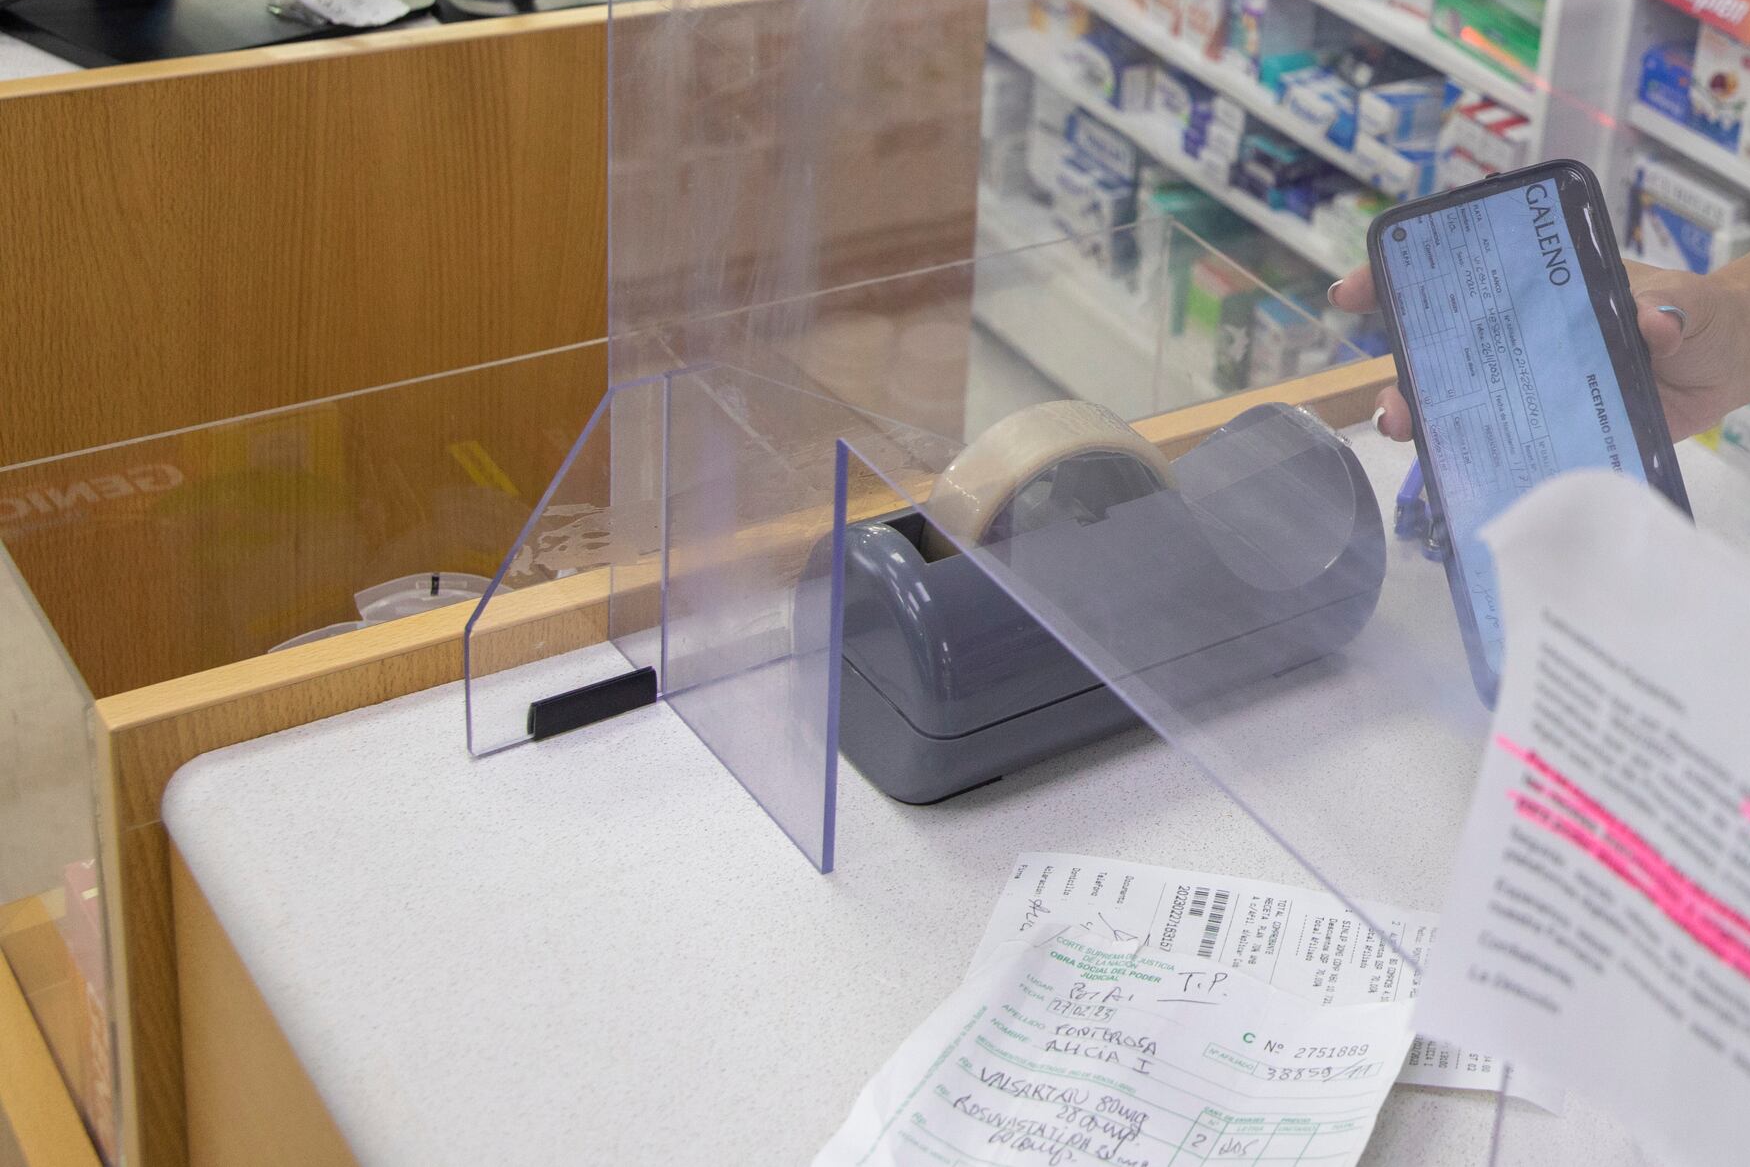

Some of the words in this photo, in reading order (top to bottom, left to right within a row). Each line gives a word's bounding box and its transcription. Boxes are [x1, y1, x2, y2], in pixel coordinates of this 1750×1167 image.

[1525, 184, 1571, 288] GALENO
[1586, 373, 1611, 434] RECETARIO
[1604, 436, 1617, 452] DE
[1259, 896, 1273, 921] RECETA
[1050, 950, 1076, 967] OBRA
[1076, 960, 1110, 976] SOCIAL
[1111, 966, 1127, 977] DEL
[1128, 968, 1162, 984] PODER
[1056, 936, 1086, 953] CORTE
[1137, 955, 1176, 972] JUSTICIA
[1025, 973, 1054, 993] LUGAR
[1080, 971, 1120, 982] JUDICIAL
[1018, 983, 1046, 1003] FECHA
[990, 1017, 1031, 1044] NOMBRE
[1002, 1003, 1047, 1031] APELLIDO
